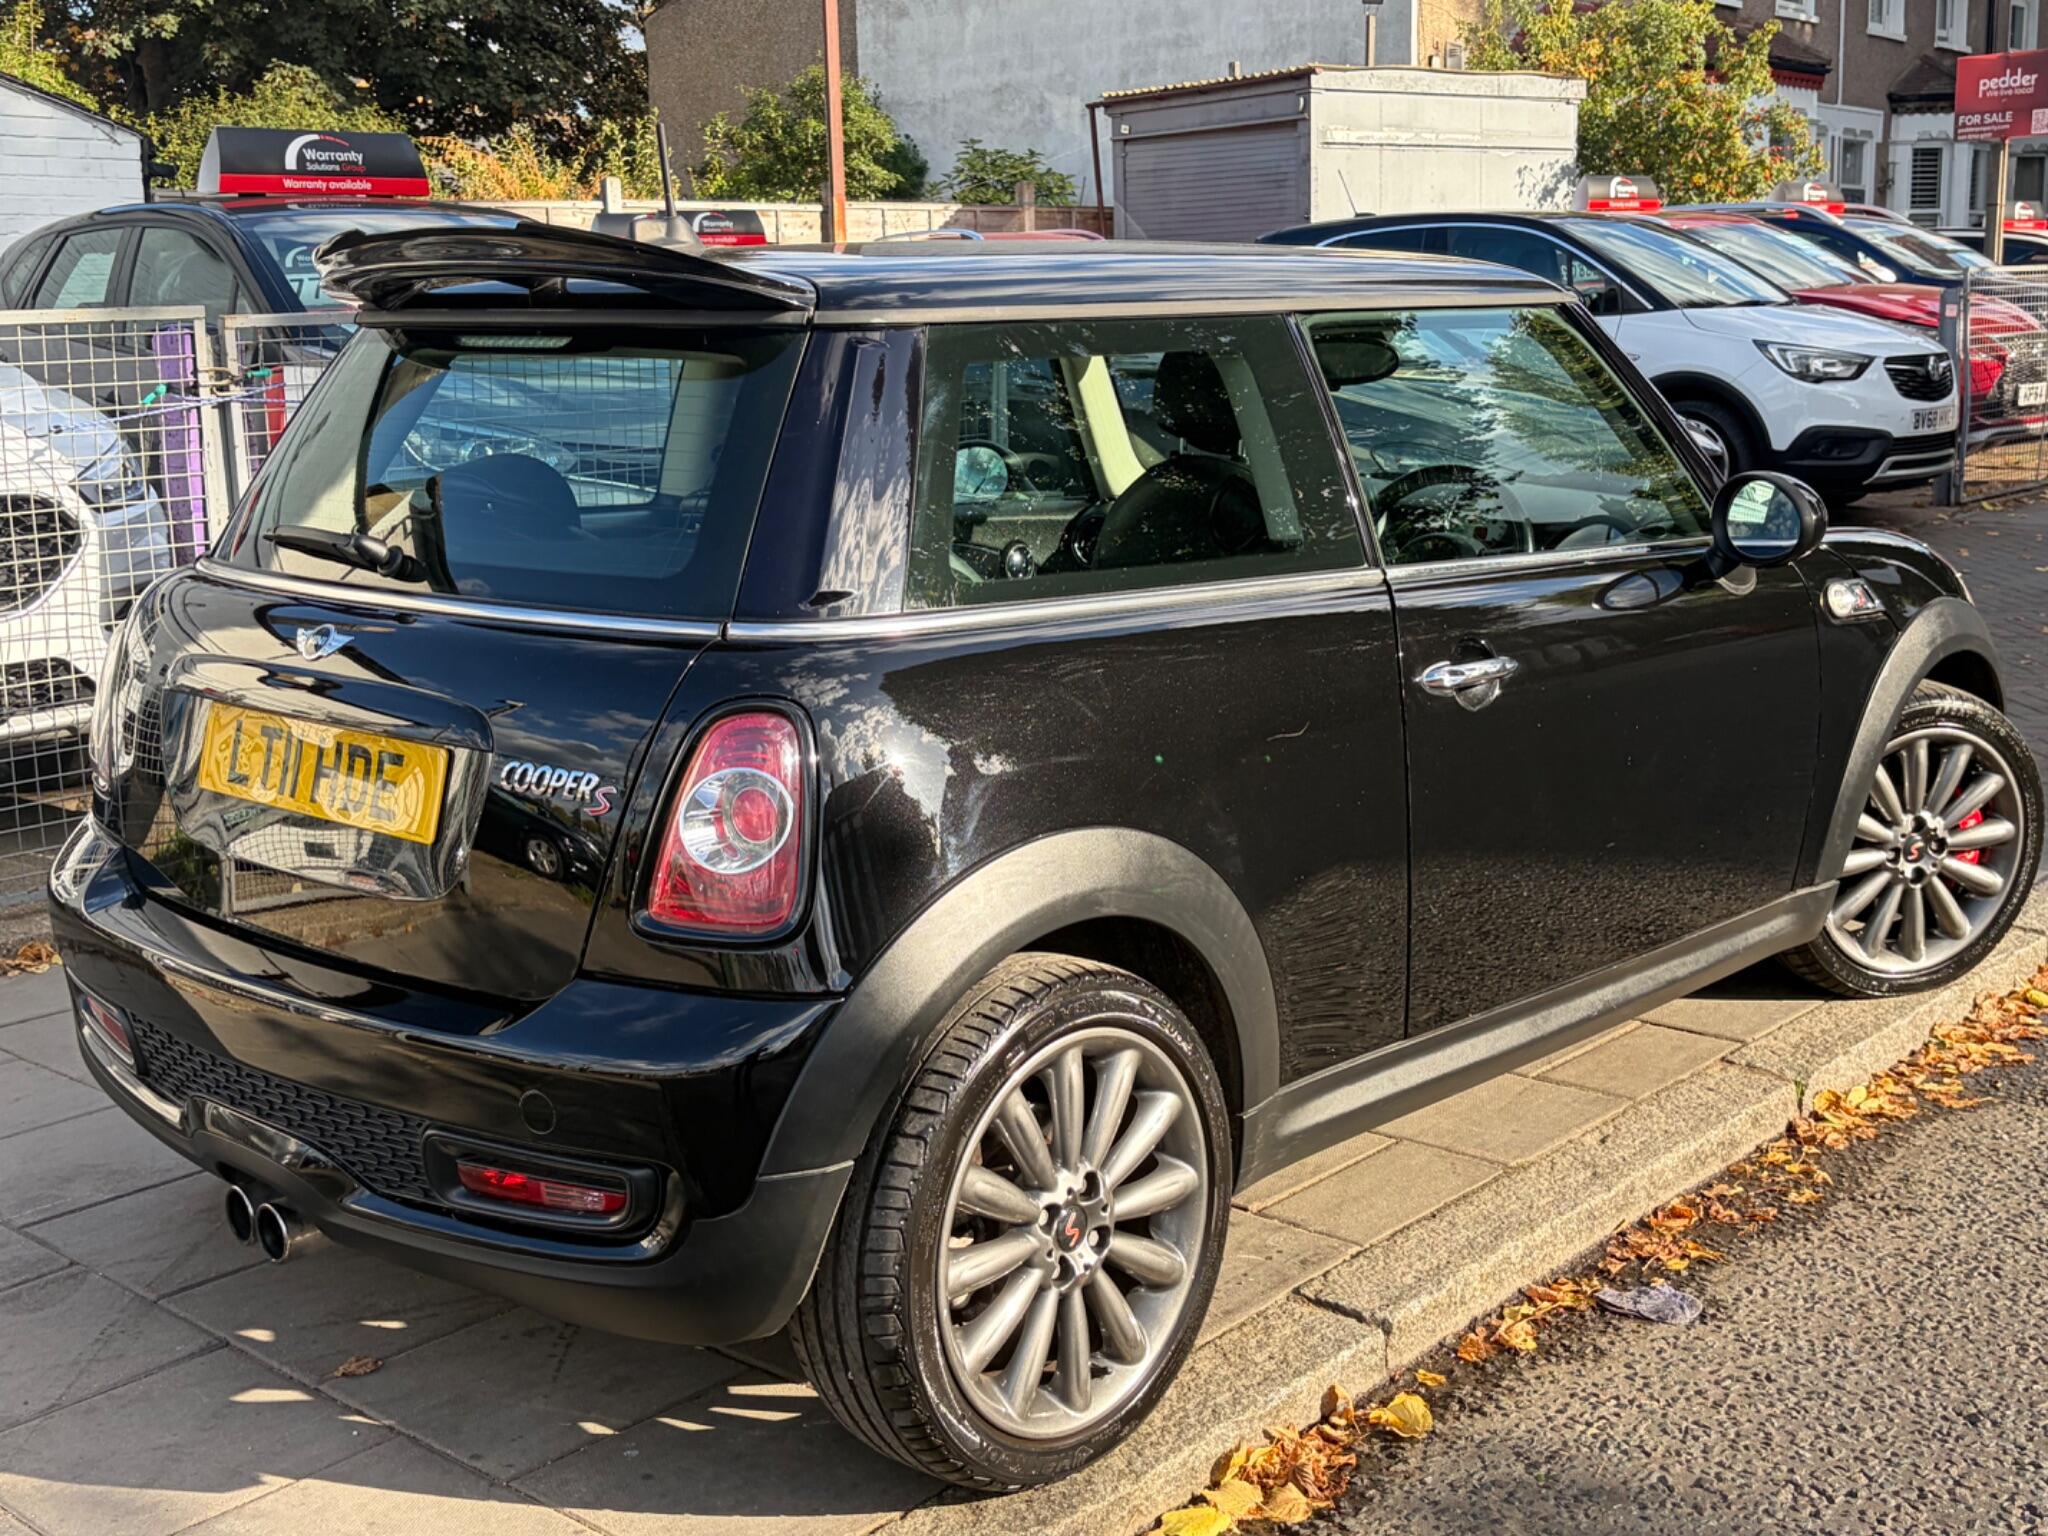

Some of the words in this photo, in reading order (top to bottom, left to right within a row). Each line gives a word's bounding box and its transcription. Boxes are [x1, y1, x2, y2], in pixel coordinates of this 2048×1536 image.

[1978, 67, 2039, 98] pedder
[1958, 114, 1982, 126] FOR
[1983, 111, 2013, 124] SALE
[303, 148, 363, 166] Warranty
[306, 162, 340, 172] Solutions
[341, 163, 367, 174] Group
[283, 178, 328, 191] Warranty
[329, 179, 372, 190] available
[1913, 410, 1938, 430] BV68
[500, 761, 600, 803] COOPER
[583, 785, 618, 817] S
